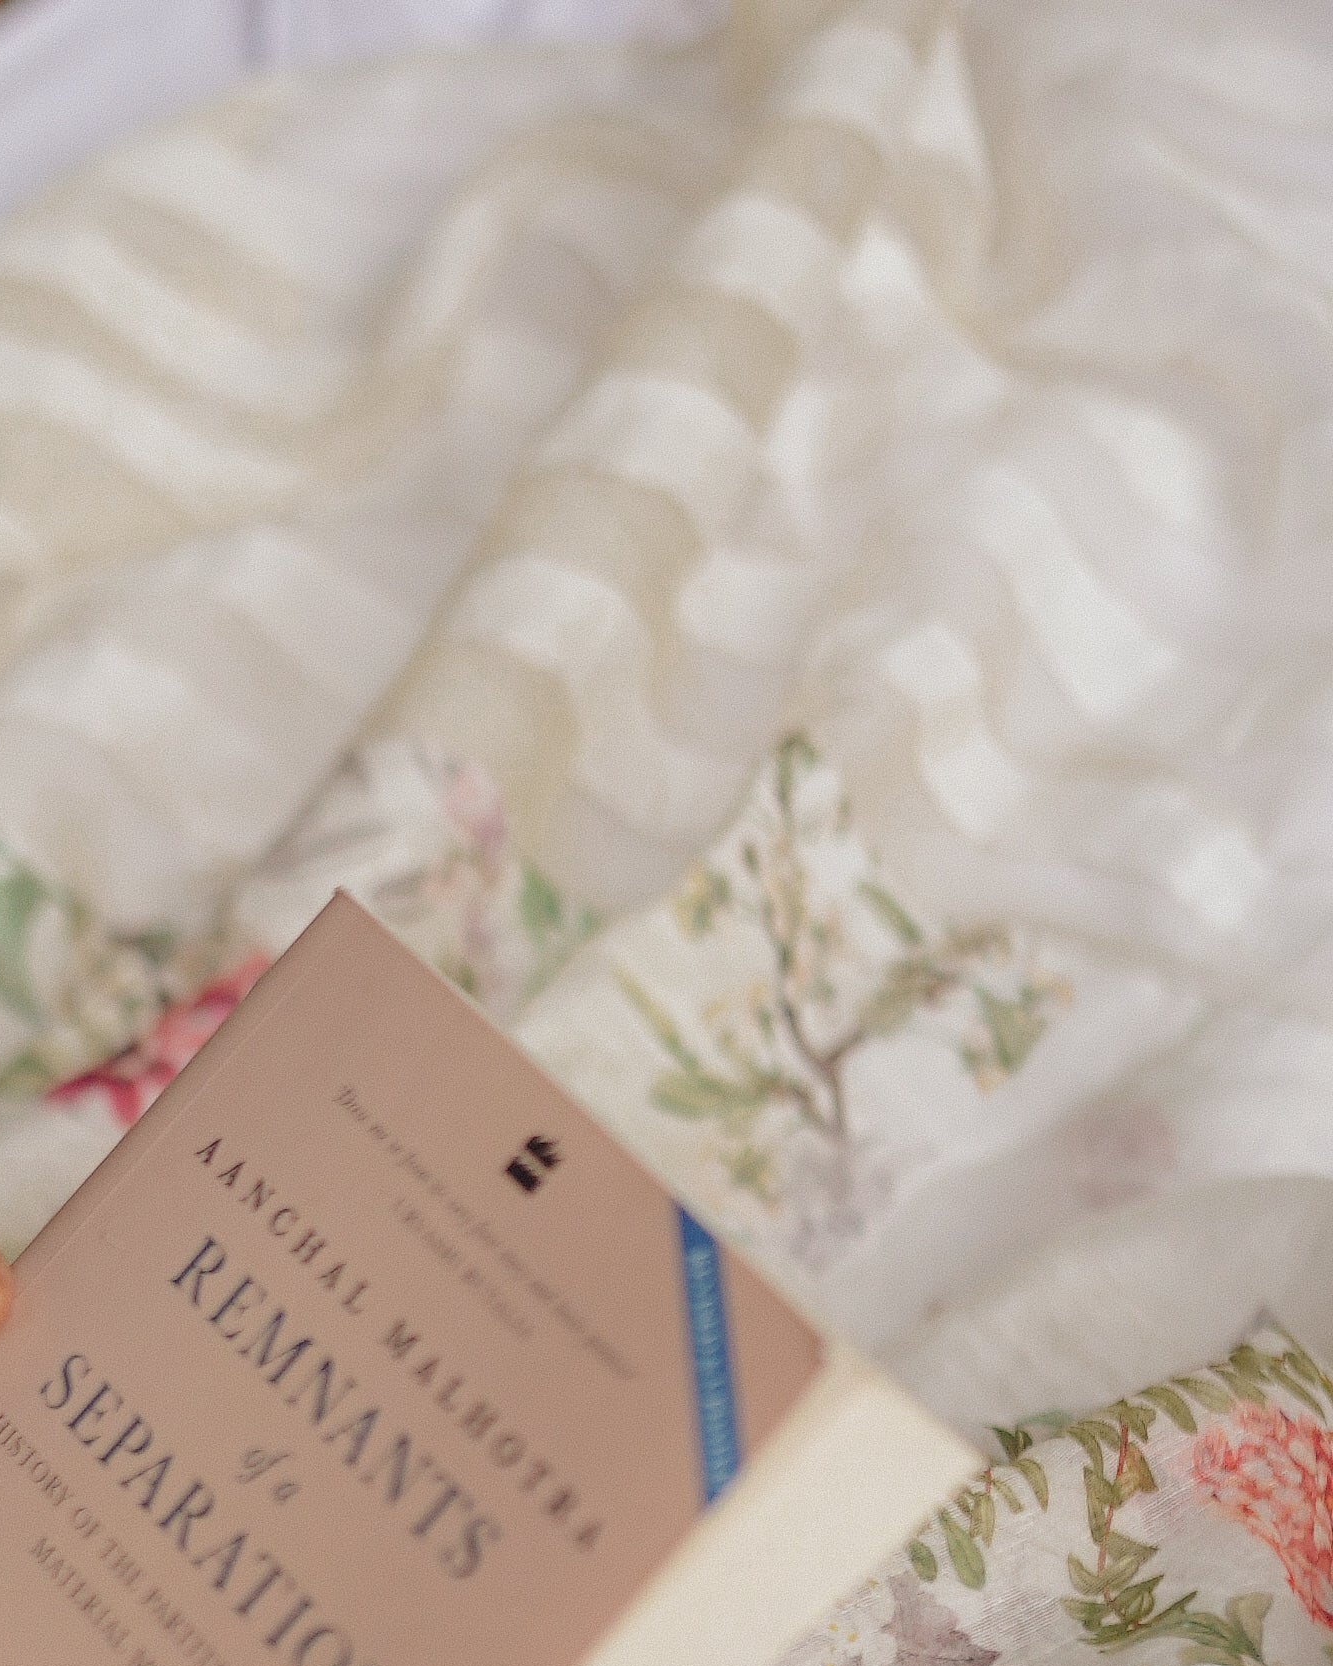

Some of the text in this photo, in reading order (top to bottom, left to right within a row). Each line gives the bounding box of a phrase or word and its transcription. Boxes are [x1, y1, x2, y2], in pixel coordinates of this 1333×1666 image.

[193, 1136, 370, 1314] AANCHAL
[381, 1318, 602, 1550] MALHOTRA
[168, 1234, 498, 1579] REMNANTS
[235, 1446, 301, 1506] of a
[27, 1535, 129, 1650] MATERIAL
[70, 1505, 102, 1540] OF
[98, 1537, 143, 1588] THE
